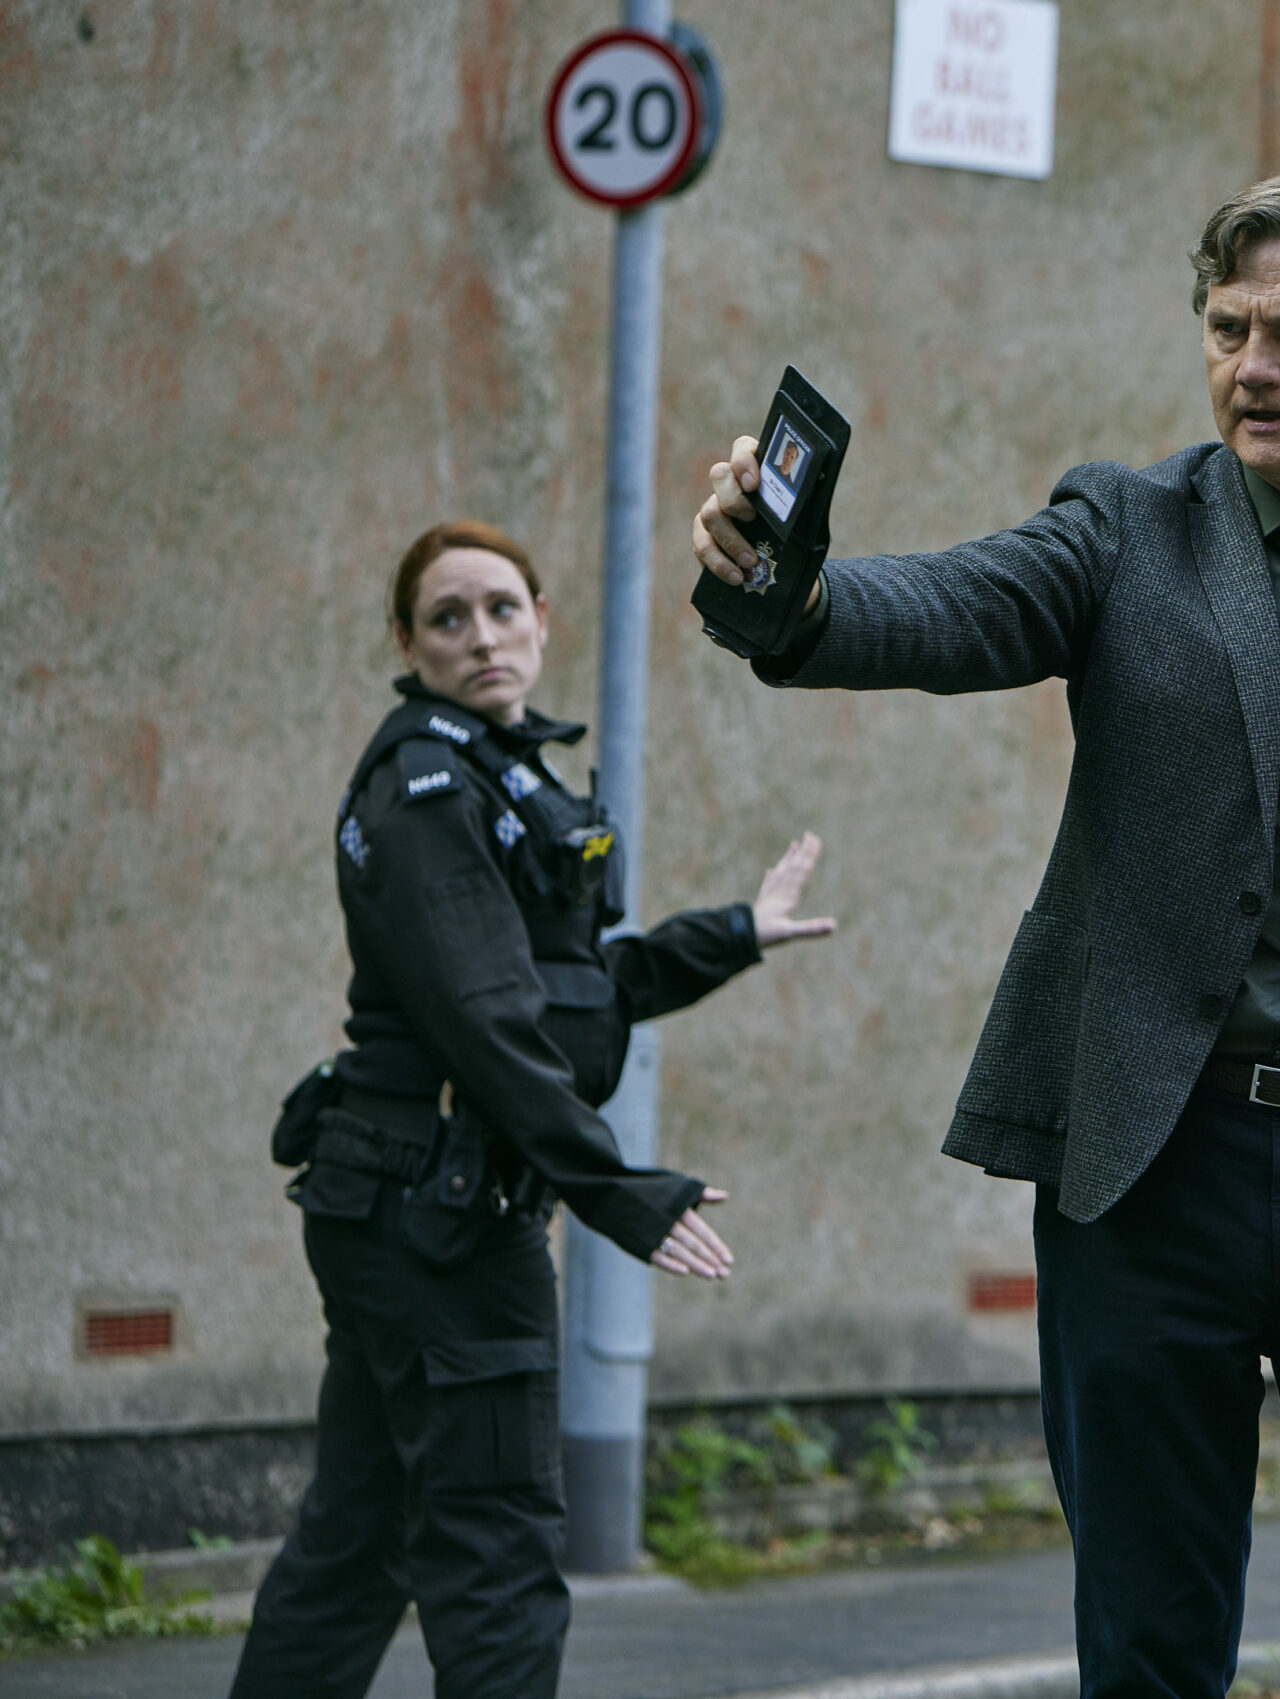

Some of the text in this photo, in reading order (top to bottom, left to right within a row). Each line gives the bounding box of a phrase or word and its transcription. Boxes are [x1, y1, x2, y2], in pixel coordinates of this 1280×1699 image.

[949, 7, 1008, 54] NO
[936, 57, 1011, 105] BALL
[575, 83, 676, 150] 20
[913, 103, 1031, 157] GAMES
